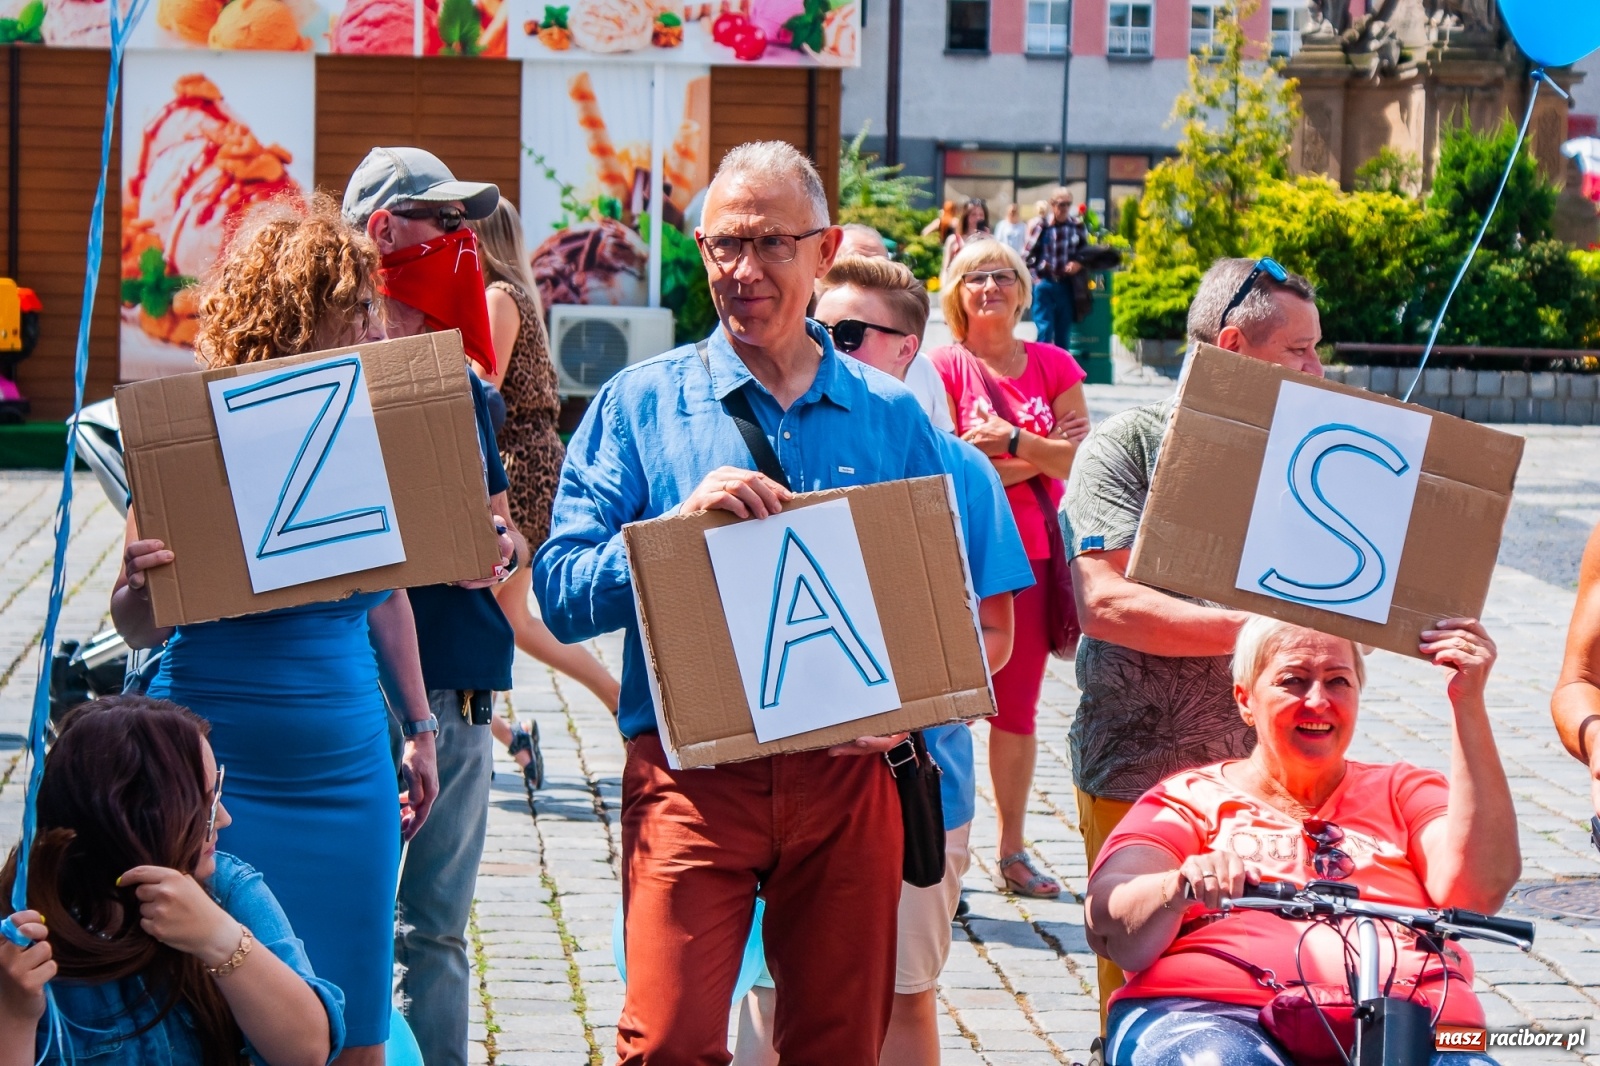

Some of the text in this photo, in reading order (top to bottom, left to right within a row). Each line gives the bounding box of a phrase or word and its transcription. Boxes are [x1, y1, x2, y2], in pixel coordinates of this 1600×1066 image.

[223, 357, 390, 560] Z
[1258, 423, 1410, 605] S
[760, 527, 889, 709] A
